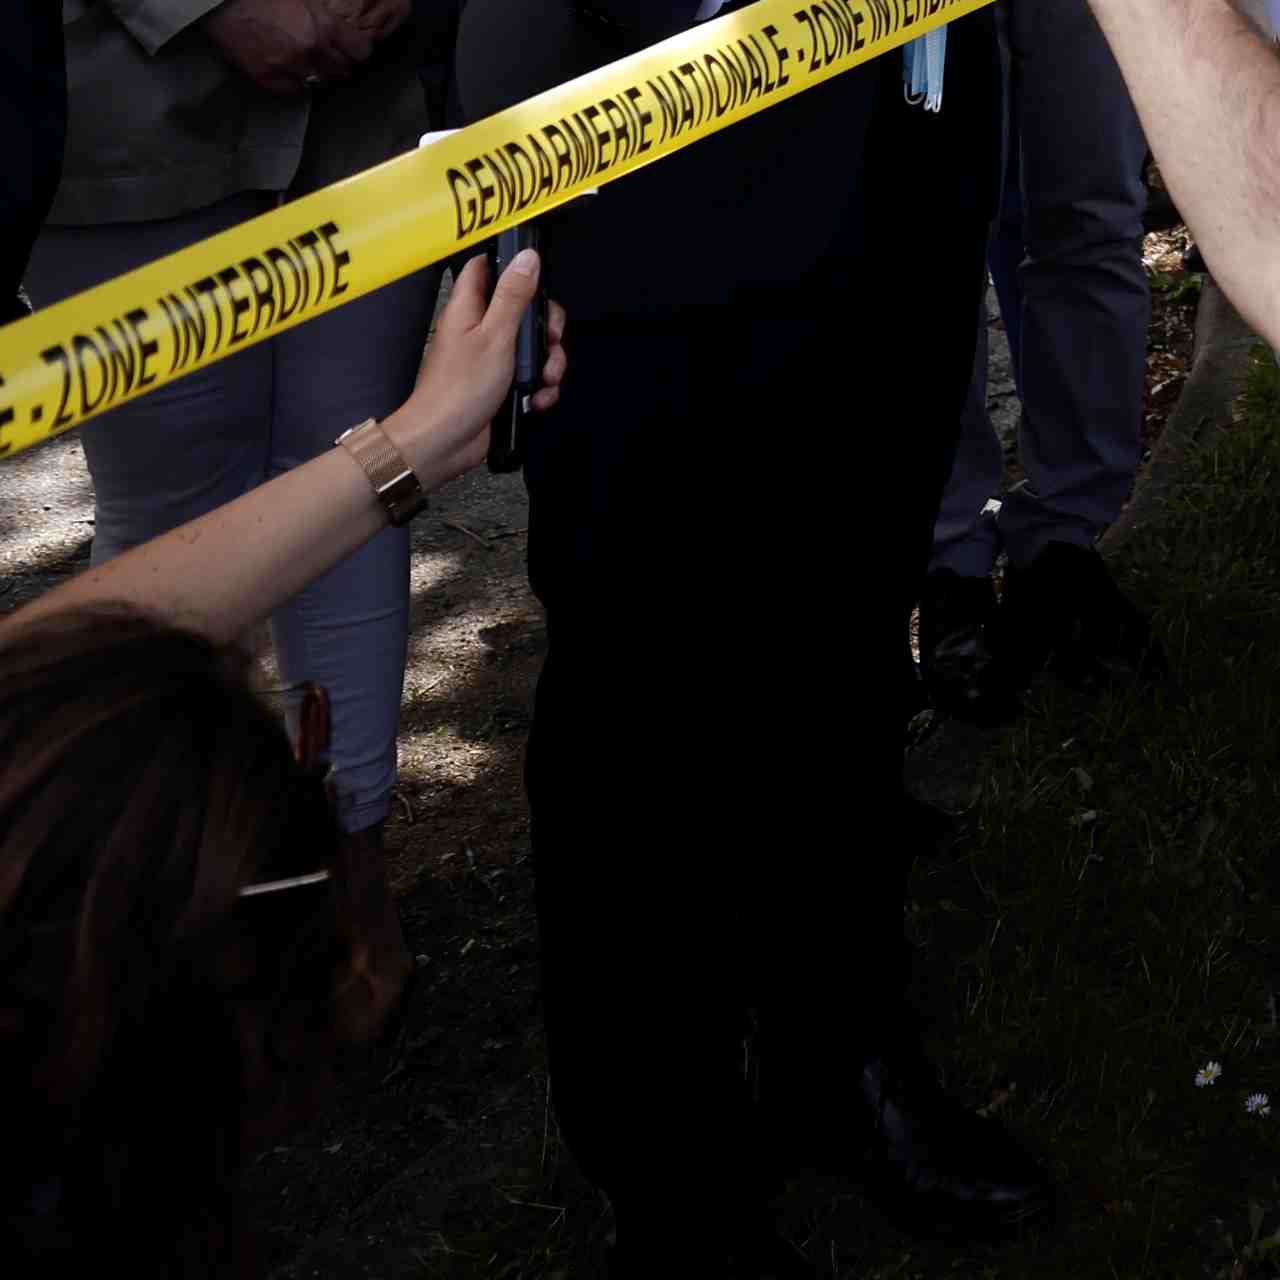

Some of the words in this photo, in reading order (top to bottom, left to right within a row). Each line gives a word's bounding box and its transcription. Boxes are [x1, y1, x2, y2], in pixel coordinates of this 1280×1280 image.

[446, 86, 653, 240] GENDARMERIE
[644, 25, 790, 143] NATIONALE
[40, 308, 159, 431] ZONE
[158, 221, 351, 375] INTERDITE
